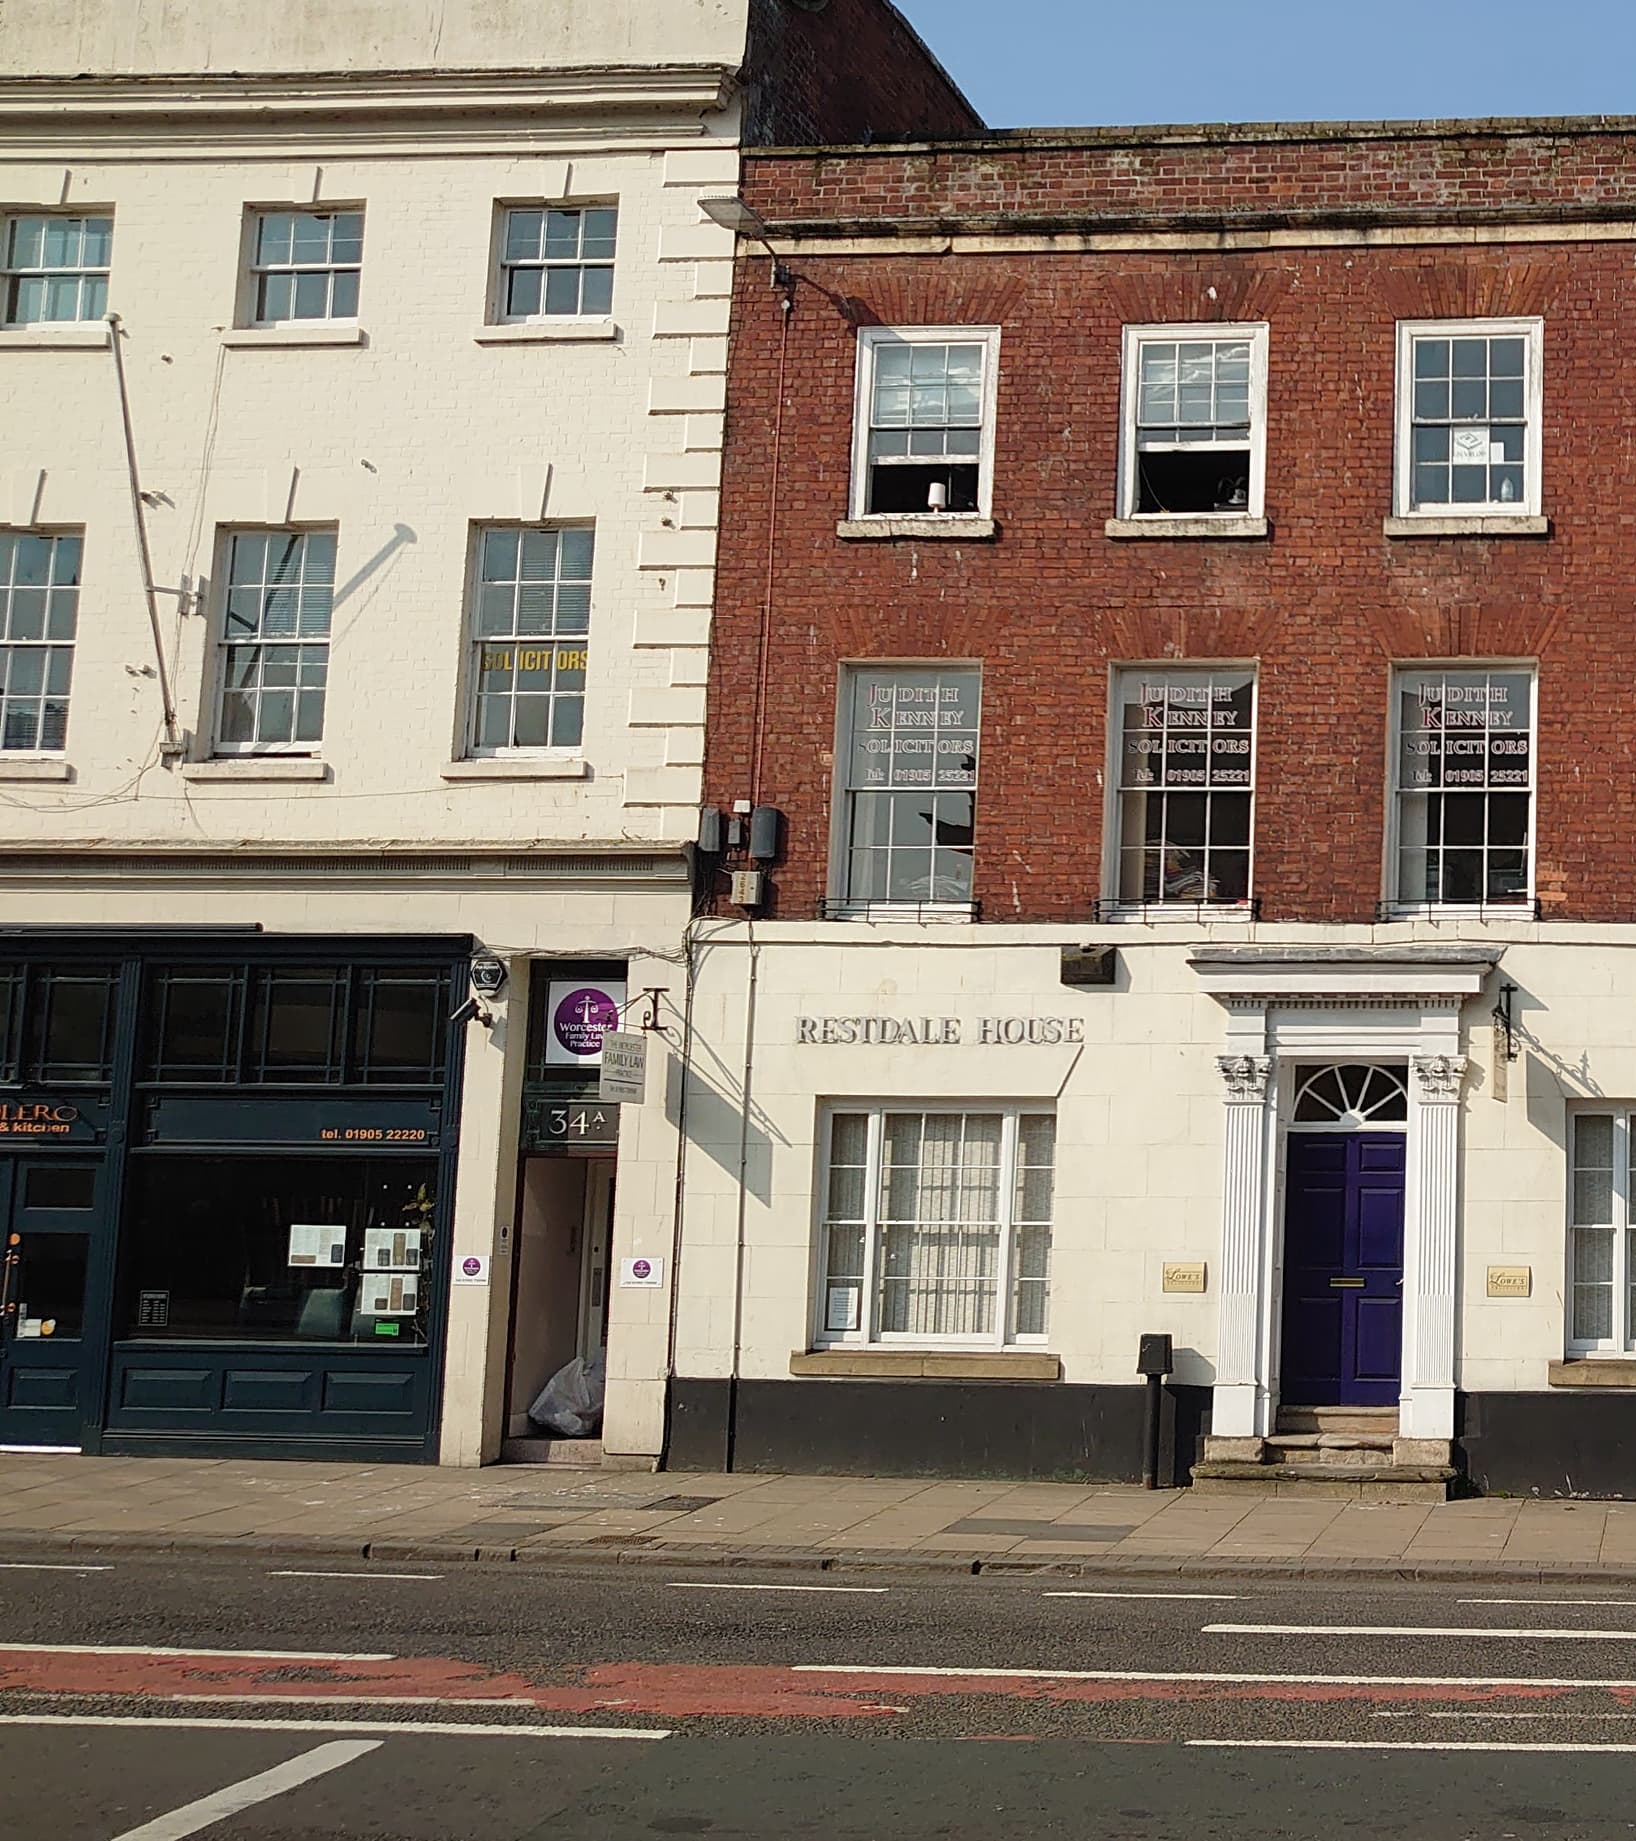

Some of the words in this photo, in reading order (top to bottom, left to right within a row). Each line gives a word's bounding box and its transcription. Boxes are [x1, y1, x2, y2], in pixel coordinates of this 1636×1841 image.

[483, 650, 588, 671] SOLICITORS
[867, 684, 959, 707] JUDITH
[1137, 682, 1232, 707] JUDITH
[1417, 682, 1508, 707] JUDITH
[870, 708, 964, 728] KENNEY
[1142, 707, 1238, 728] KENNEY
[1421, 707, 1513, 728] KENNEY
[858, 739, 974, 754] SOLICITORS
[1128, 739, 1249, 754] SOLICITORS
[1407, 740, 1528, 755] SOLICITORS
[565, 1032, 590, 1041] Family
[796, 1016, 961, 1045] RESTDALE
[977, 1016, 1086, 1045] HOUSE
[570, 1040, 600, 1048] Practice
[605, 1051, 628, 1067] FAMILY
[629, 1055, 644, 1069] LAW
[0, 1103, 78, 1122] LERO
[321, 1129, 342, 1139] tel.
[345, 1129, 383, 1139] 01905
[385, 1129, 425, 1140] 22220
